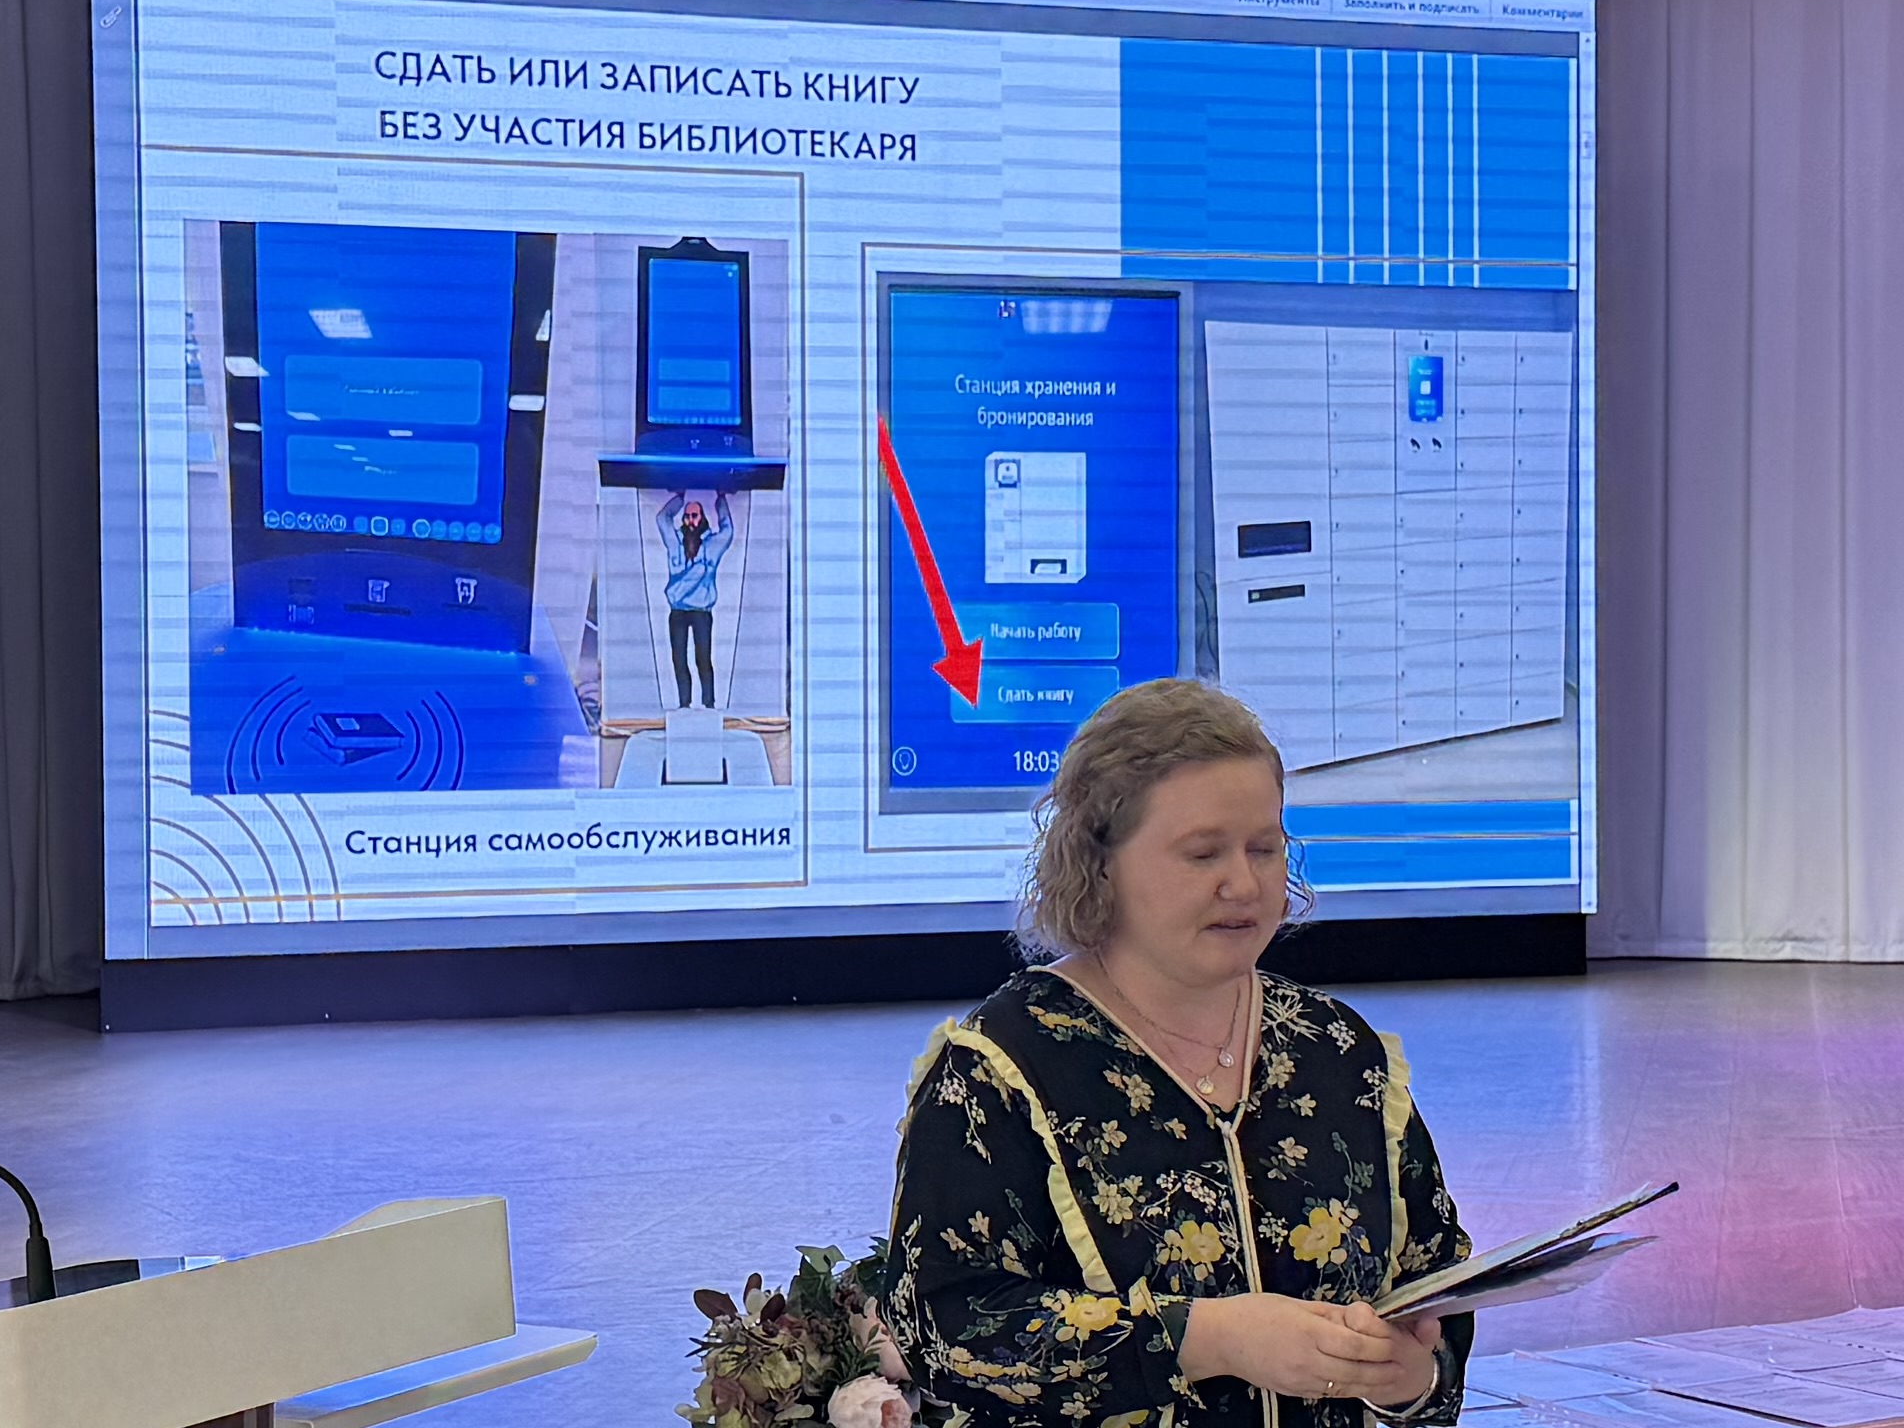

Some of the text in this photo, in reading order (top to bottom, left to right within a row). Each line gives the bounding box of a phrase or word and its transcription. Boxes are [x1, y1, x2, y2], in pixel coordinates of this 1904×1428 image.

[1419, 2, 1479, 16] подписать
[1502, 4, 1584, 21] Комментарии
[375, 50, 921, 105] СДАТЬ ИЛИ ЗАПИСАТЬ КНИГУ
[379, 110, 918, 162] БЕЗ УЧАСТИЯ БИБЛИОТЕКАРЯ
[955, 373, 1117, 400] Станция хранения и
[977, 405, 1094, 430] бронирования
[990, 622, 1083, 643] Начать работу
[998, 686, 1075, 705] Сдать книгу
[1012, 750, 1061, 773] 18:03
[344, 821, 793, 859] Станция самообслуживания
